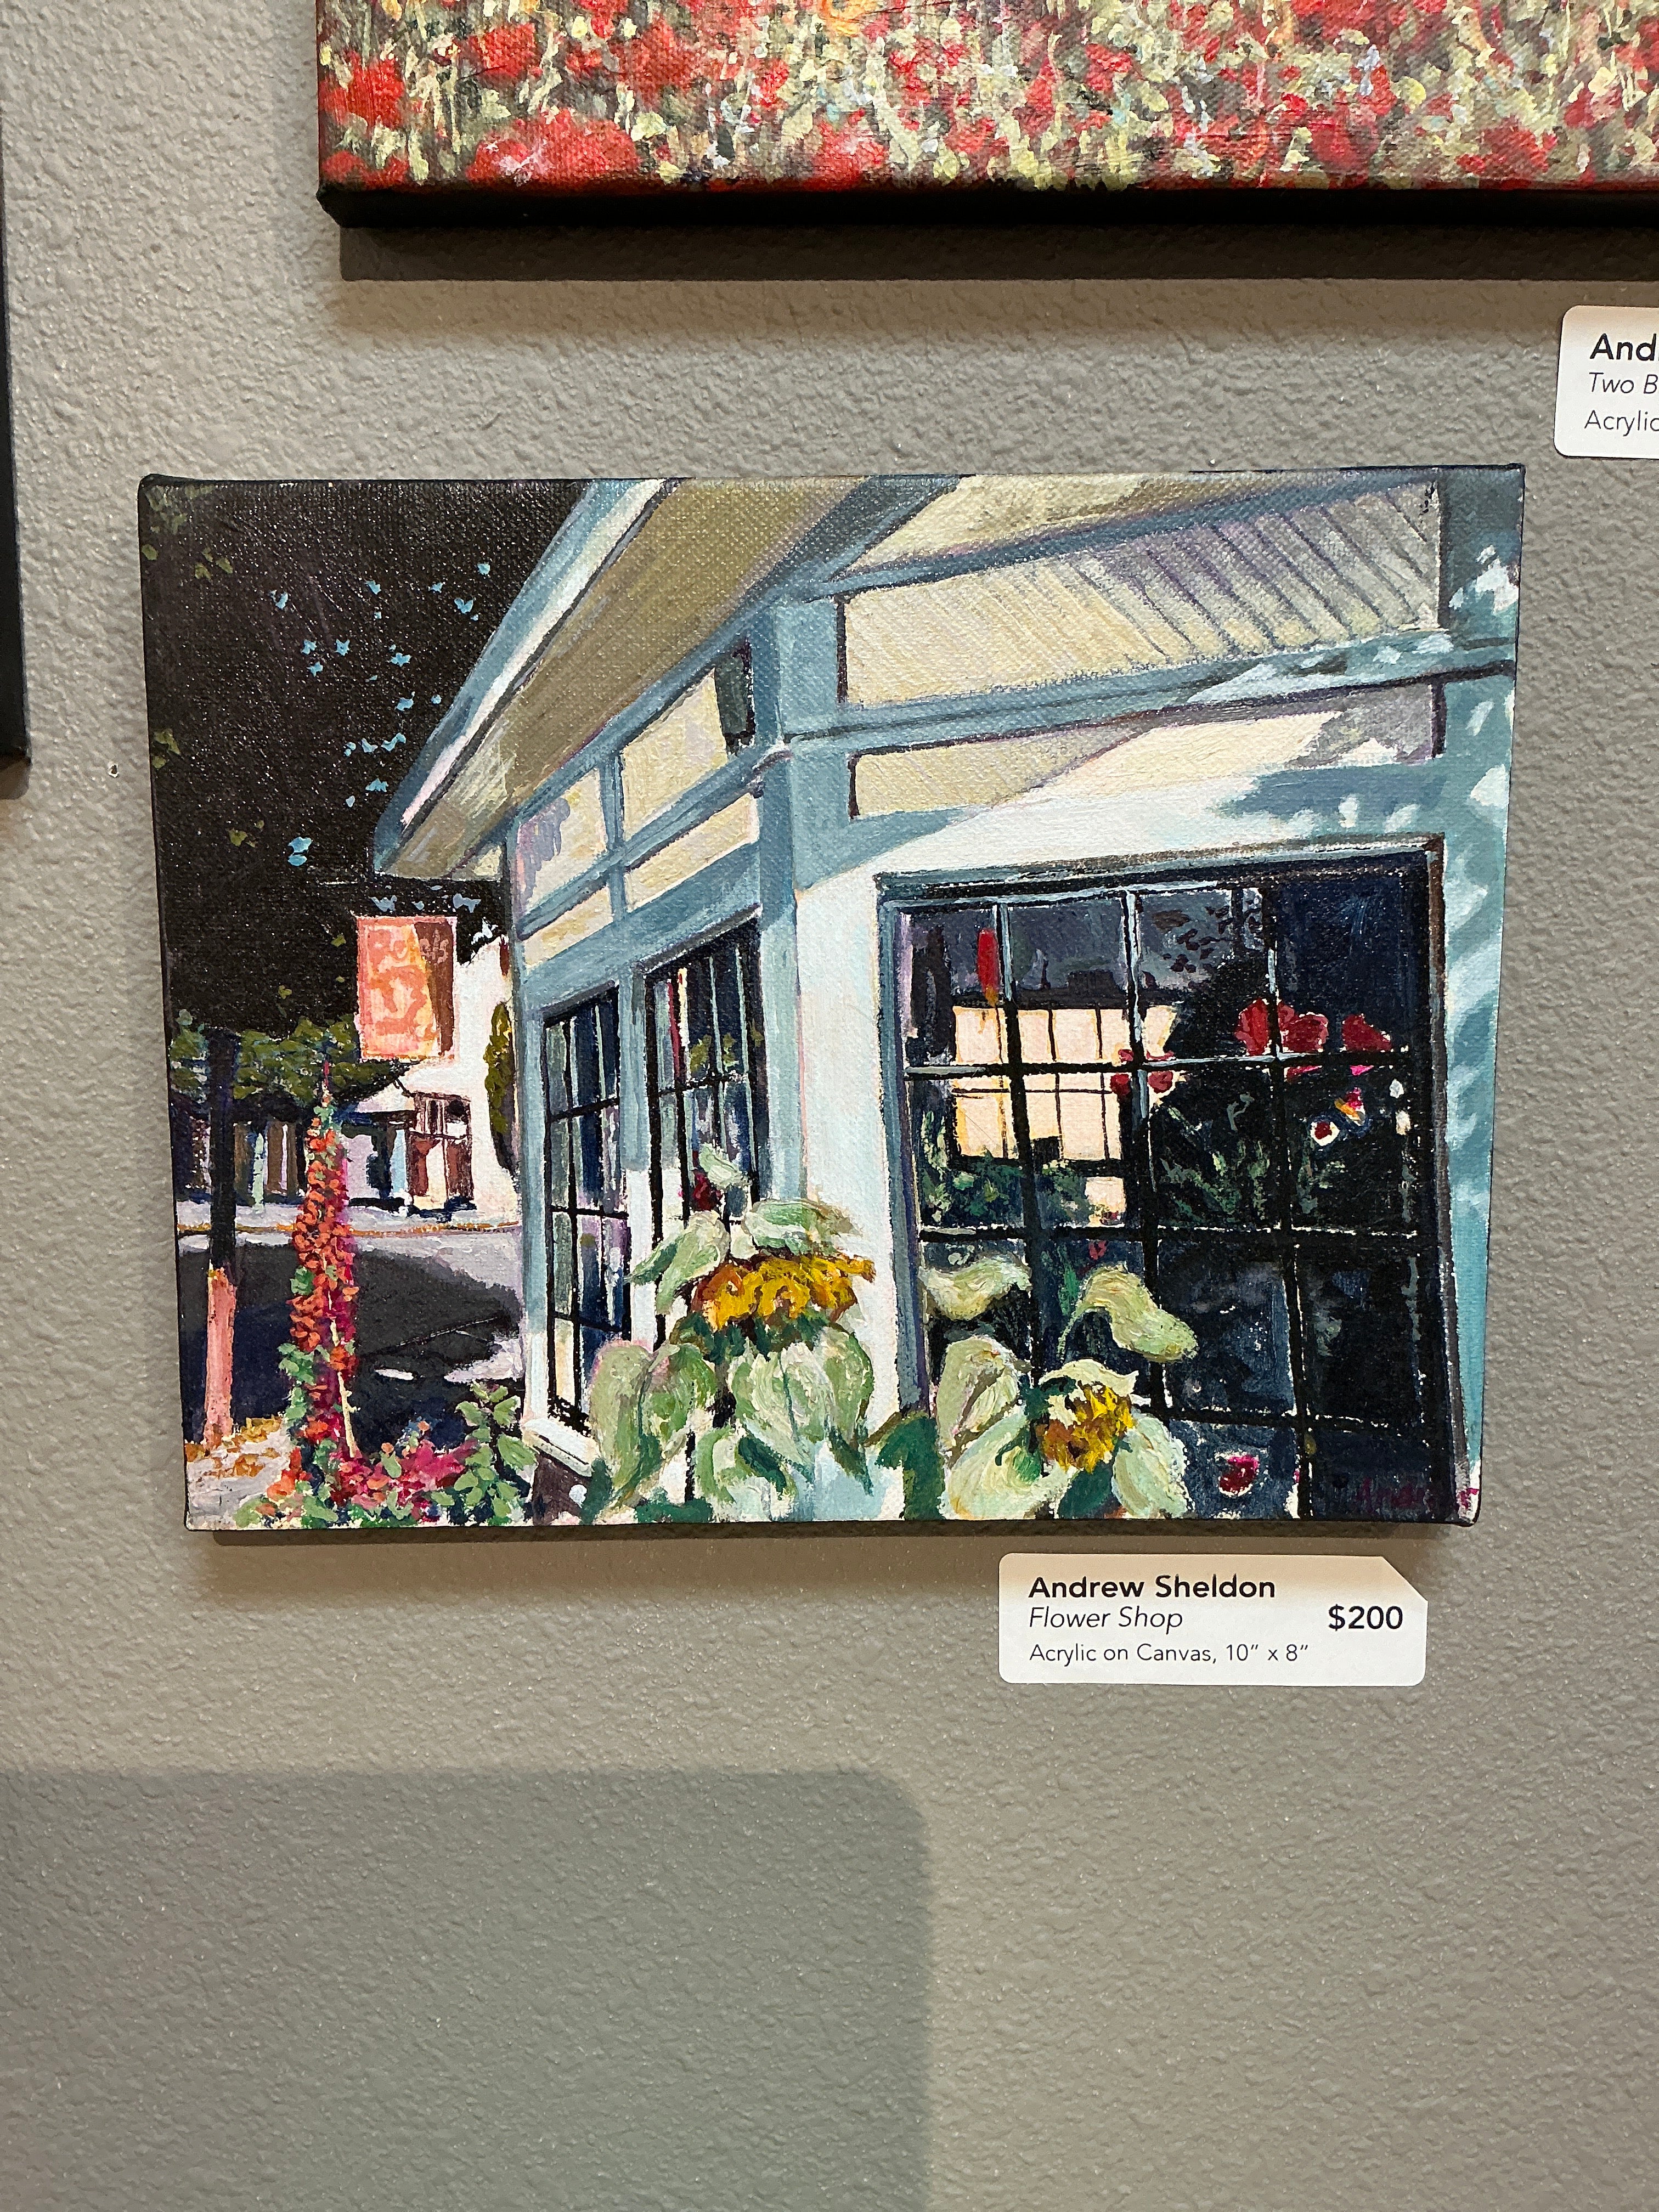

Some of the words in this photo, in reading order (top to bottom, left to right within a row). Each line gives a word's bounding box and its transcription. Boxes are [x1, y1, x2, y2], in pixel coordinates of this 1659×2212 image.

[1589, 332, 1659, 362] And
[1589, 371, 1634, 394] Two
[1584, 409, 1659, 437] Acrylic
[1028, 1576, 1145, 1598] Andrew
[1155, 1573, 1275, 1598] Sheldon
[1029, 1606, 1111, 1628] Flower
[1118, 1605, 1183, 1635] Shop
[1328, 1603, 1403, 1632] $200
[1029, 1643, 1097, 1667] Acrylic
[1103, 1649, 1128, 1661] on
[1137, 1643, 1216, 1664] Canvas,
[1268, 1649, 1278, 1661] x
